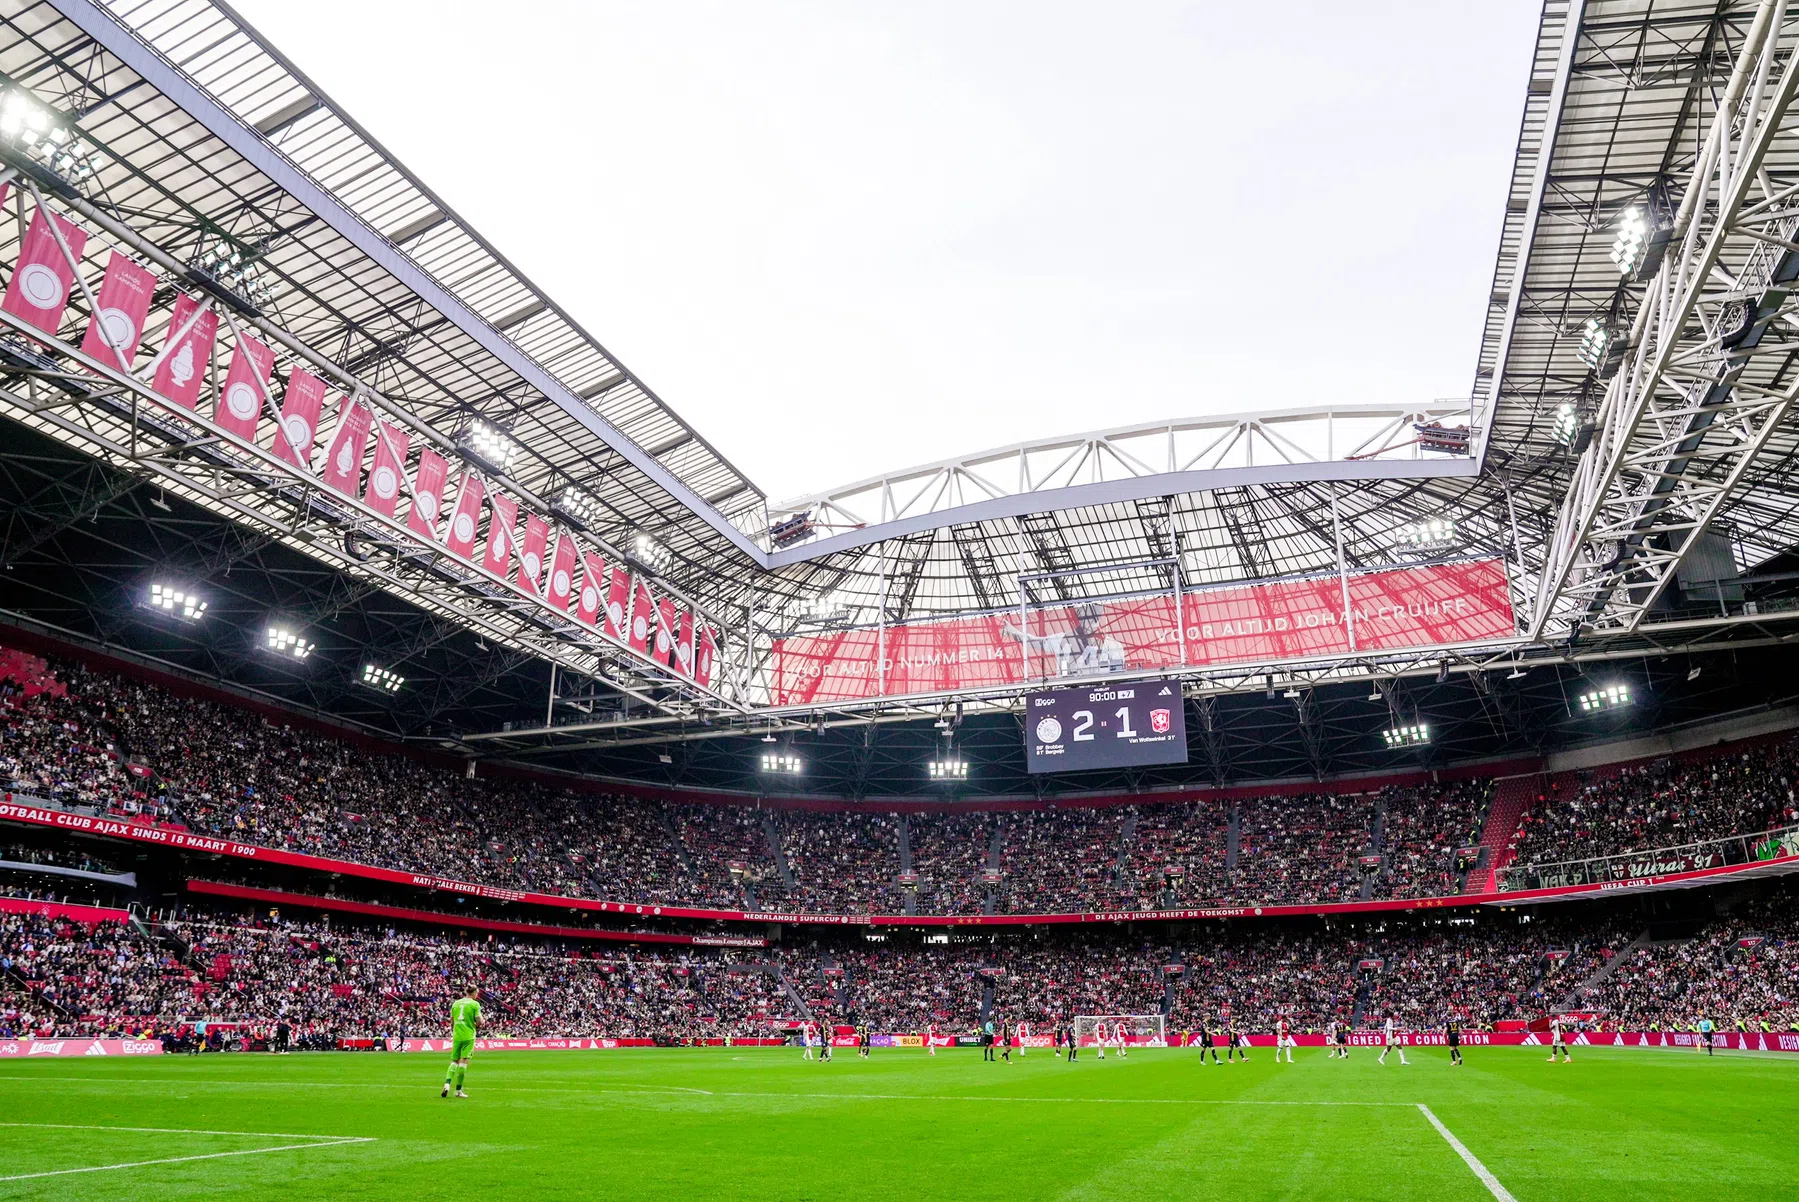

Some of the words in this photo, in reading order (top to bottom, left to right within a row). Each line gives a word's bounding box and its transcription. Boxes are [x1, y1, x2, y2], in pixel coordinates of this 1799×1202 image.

[1221, 616, 1287, 637] ALTIJD
[1295, 608, 1369, 630] JOHAN
[900, 650, 979, 669] NUMMER
[1090, 691, 1115, 702] 90:00
[1072, 710, 1095, 742] 2
[1115, 706, 1137, 738] 1
[57, 814, 91, 829] CLUB
[94, 821, 128, 837] AJAX
[132, 827, 167, 842] SINDS
[170, 833, 184, 845] 18
[187, 838, 227, 852] MAART
[232, 844, 256, 858] 1900
[454, 883, 476, 894] BEKER
[1627, 879, 1646, 888] CUP
[743, 913, 797, 922] NEDERLANDSE
[799, 915, 840, 923] SUPERCUP
[1108, 913, 1129, 921] AJAX
[1131, 912, 1157, 920] JEUGD
[1159, 911, 1186, 919] HEEFT
[1187, 910, 1198, 918] DE
[1200, 908, 1245, 918] TOEKOMST
[902, 1037, 922, 1045] BLOX
